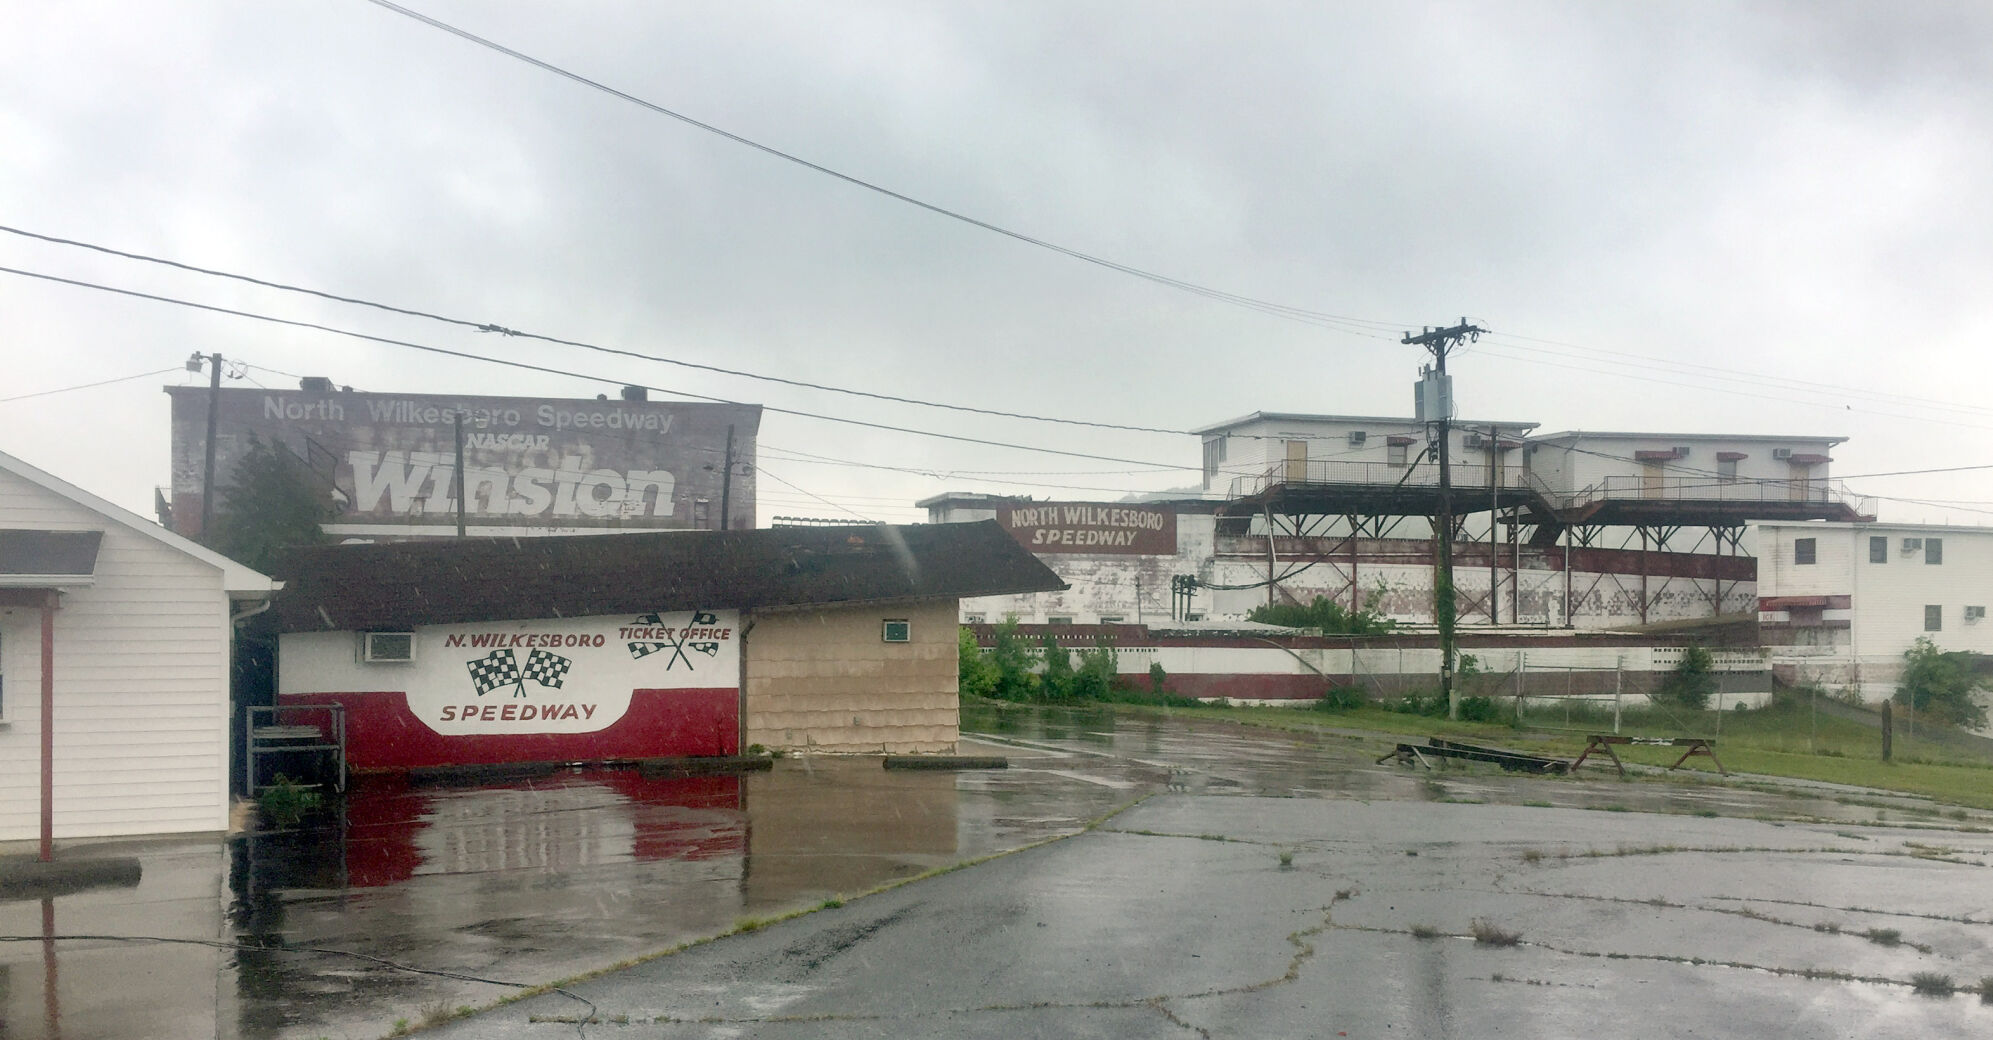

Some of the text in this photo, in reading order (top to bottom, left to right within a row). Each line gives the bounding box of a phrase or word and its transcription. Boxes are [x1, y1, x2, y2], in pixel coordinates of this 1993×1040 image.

[264, 396, 674, 434] North Wilkesboro Speedway
[465, 433, 550, 450] NASCAR
[345, 450, 676, 517] Winston
[1011, 506, 1164, 531] NORTH WILKESBORO
[1032, 529, 1137, 546] SPEEDWAY
[619, 627, 731, 640] TICKET OFFICE
[440, 704, 597, 721] SPEEDWAY
